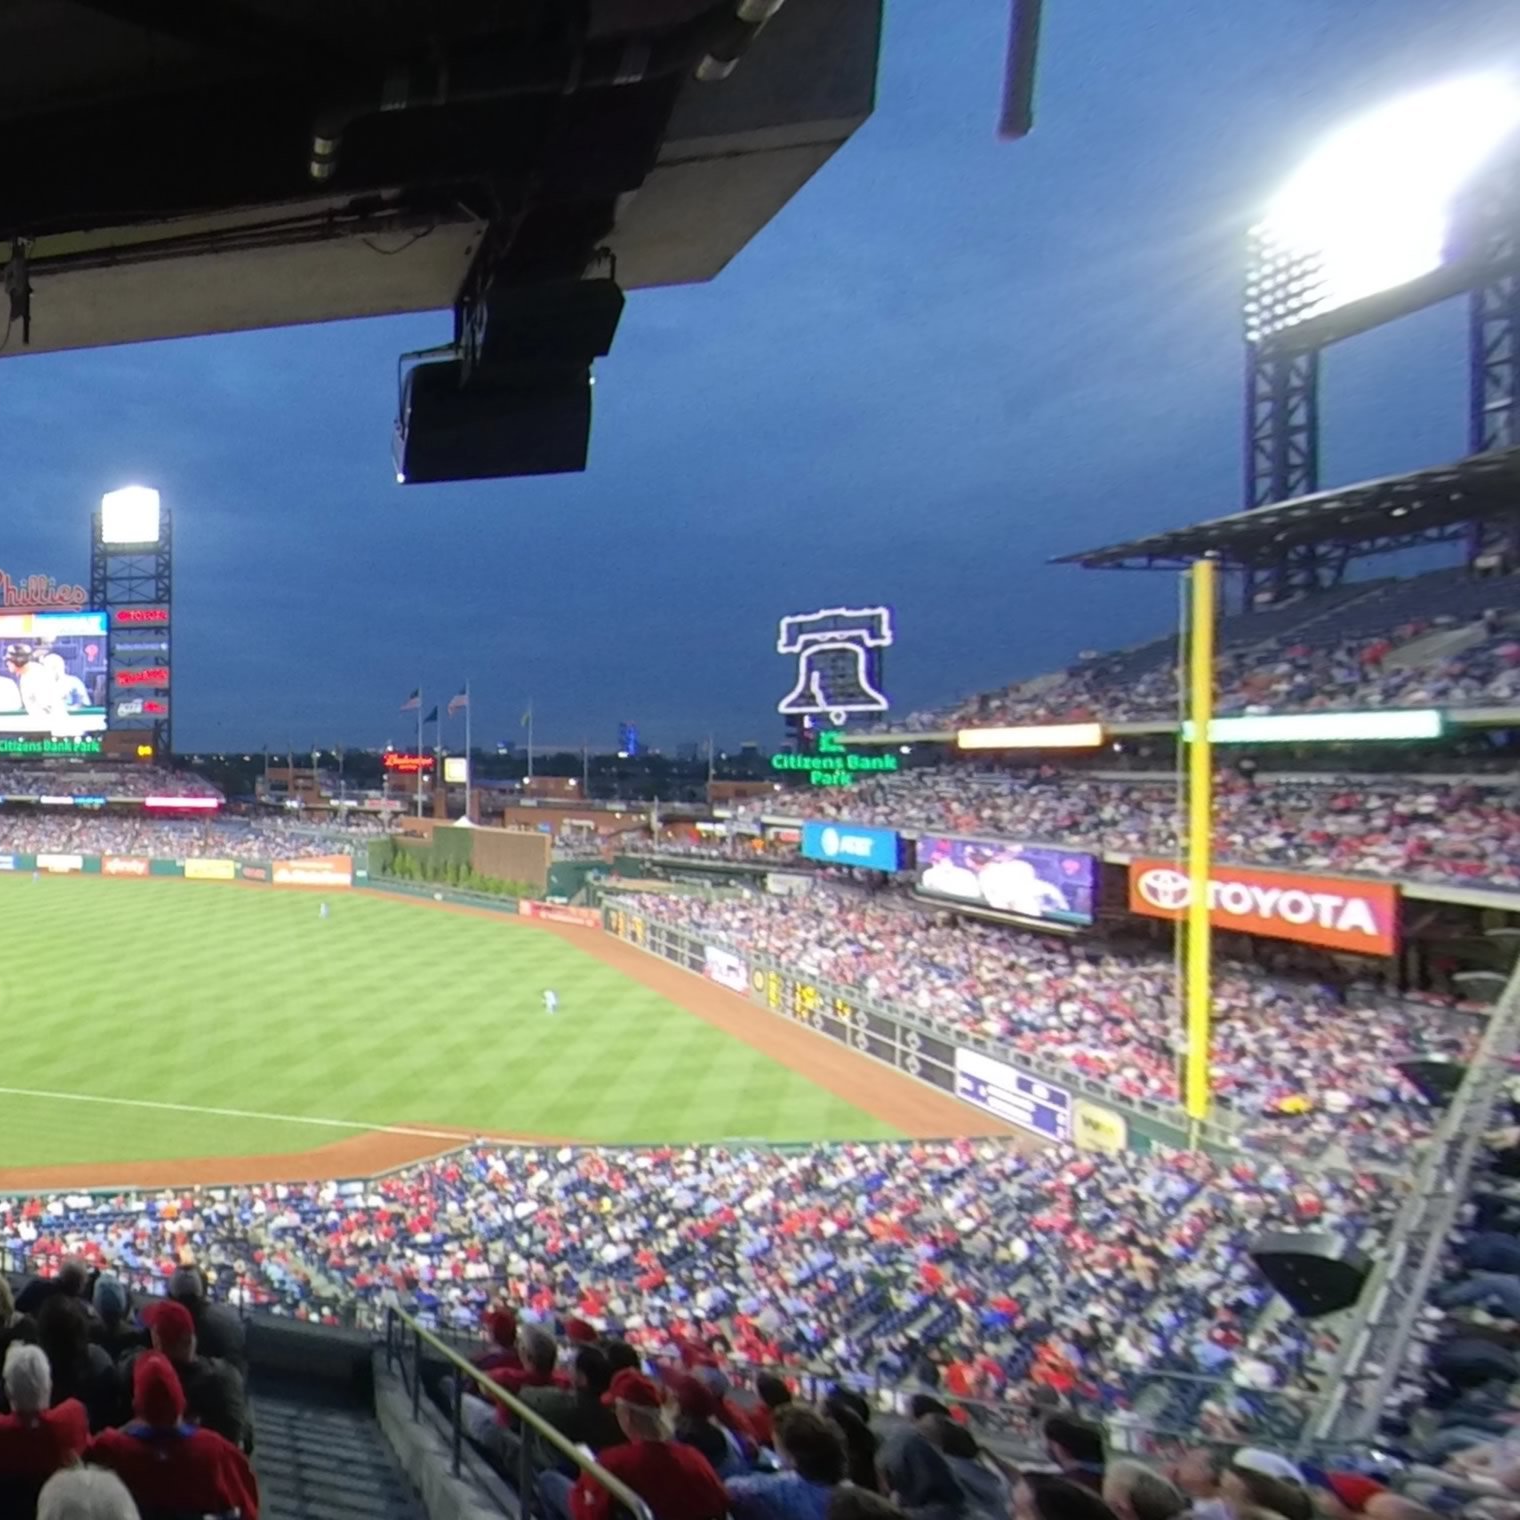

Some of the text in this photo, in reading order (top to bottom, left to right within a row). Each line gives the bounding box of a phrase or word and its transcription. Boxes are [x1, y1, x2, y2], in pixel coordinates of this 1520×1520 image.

[43, 739, 72, 752] Bank
[73, 740, 100, 752] Park
[772, 753, 897, 769] Citizens Bank
[811, 770, 851, 785] Park
